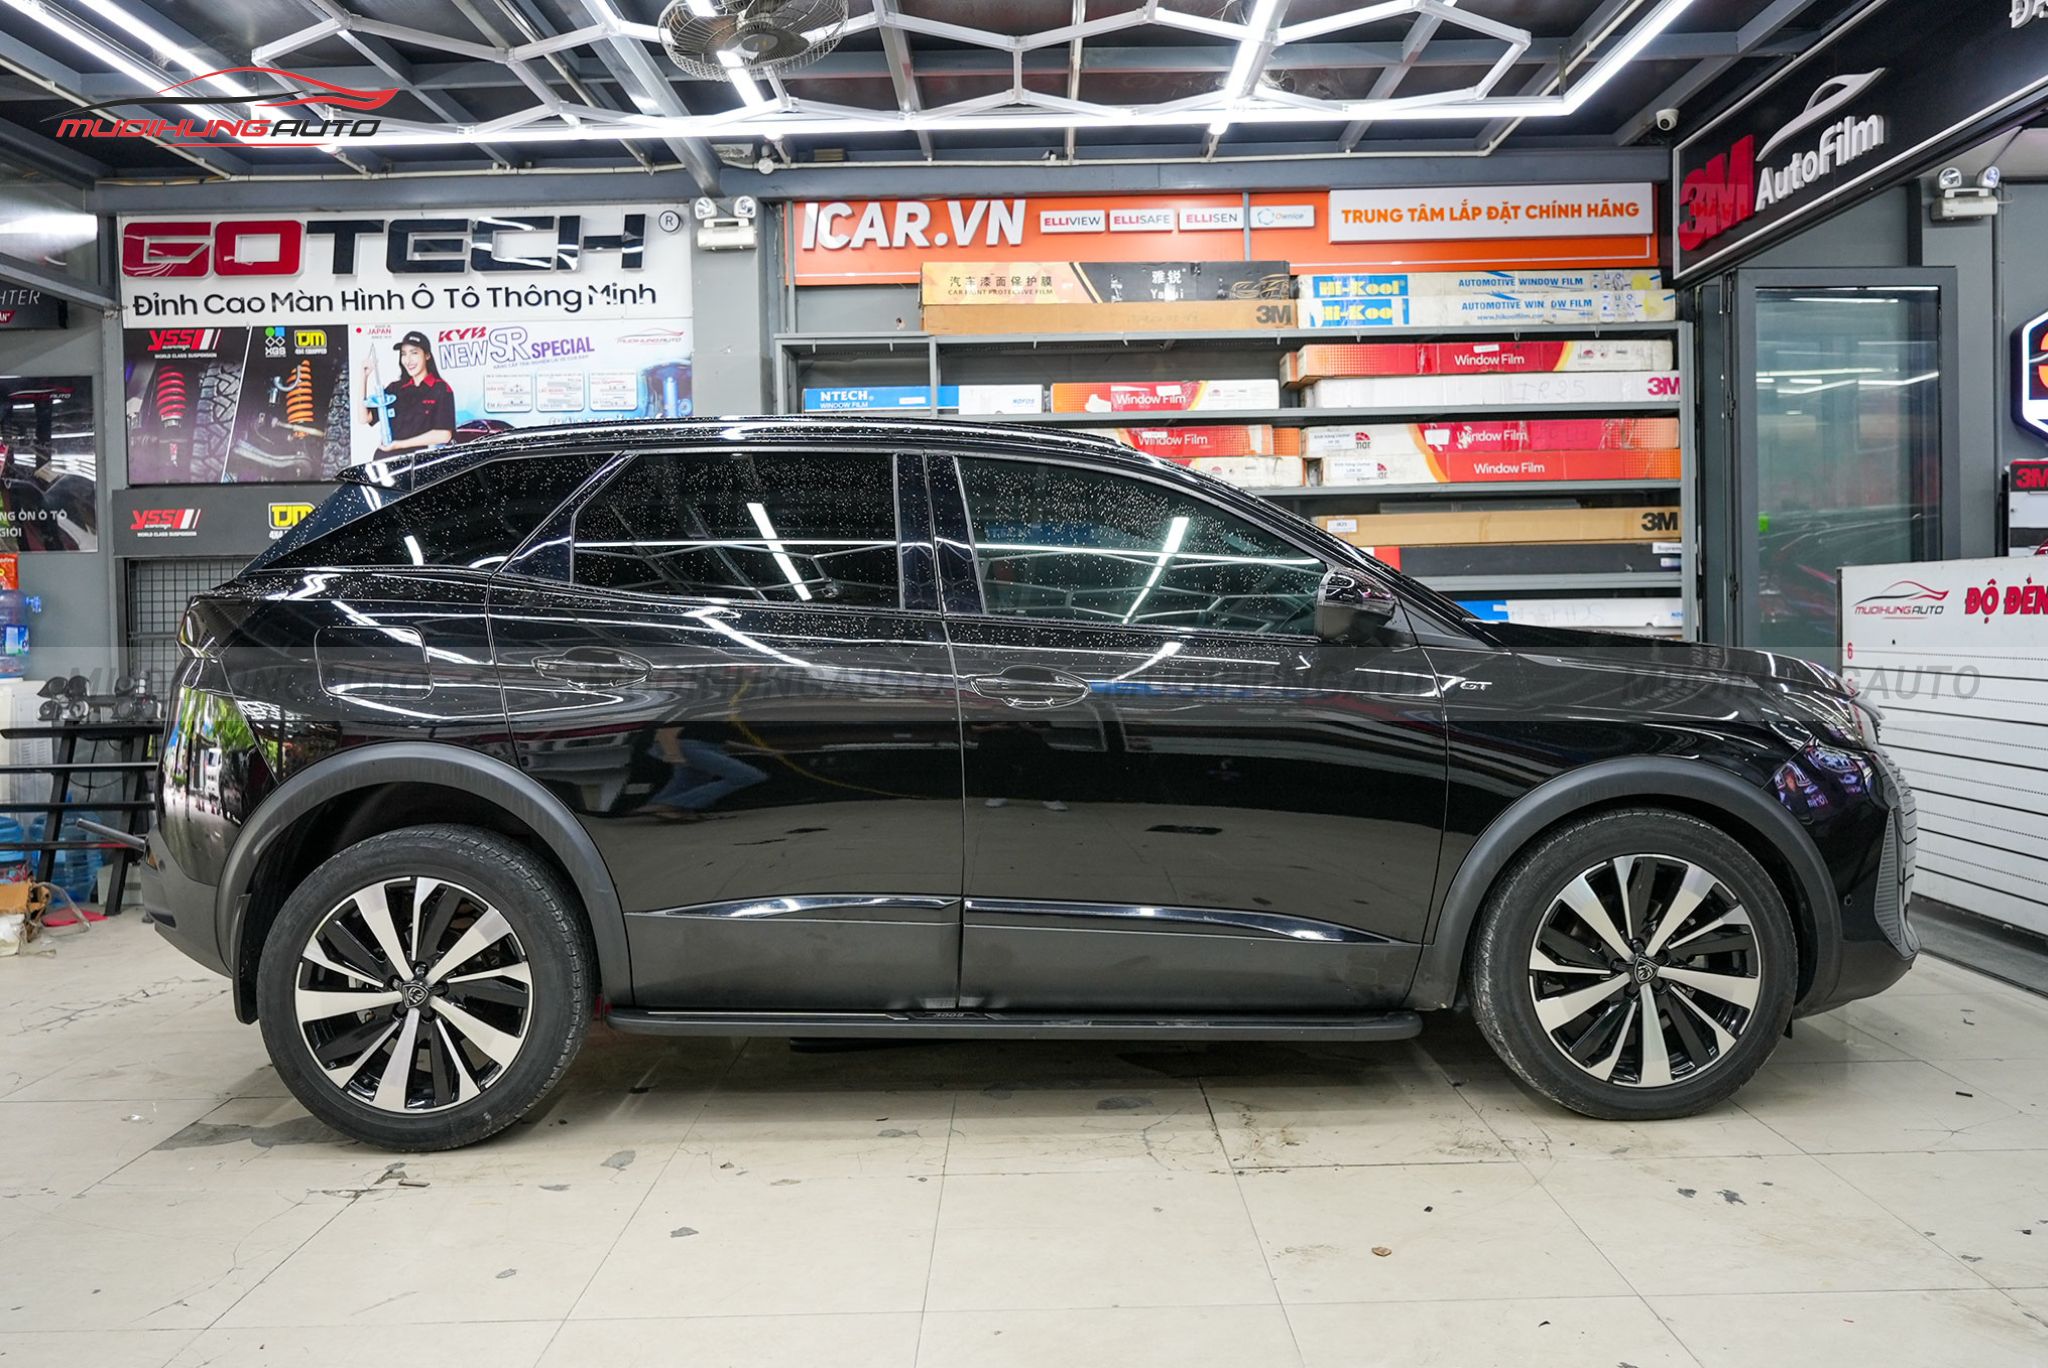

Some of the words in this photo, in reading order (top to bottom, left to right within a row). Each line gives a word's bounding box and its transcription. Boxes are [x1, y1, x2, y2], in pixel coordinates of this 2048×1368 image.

[1679, 134, 1755, 250] 3M
[1755, 115, 1885, 212] AutoFilm
[1186, 213, 1239, 223] ELLISEN
[1341, 207, 1404, 223] TRUNG
[1407, 203, 1445, 222] TÂM
[1449, 198, 1482, 221] LẮP
[1487, 201, 1521, 224] ĐẶT
[1525, 200, 1583, 219] CHÍNH
[1587, 198, 1639, 218] HÃNG
[803, 199, 1026, 249] ICAR.VN
[1044, 217, 1101, 227] ELLIVIEW
[1113, 215, 1171, 225] ELLISAFE
[122, 213, 647, 277] GOTECH
[1458, 278, 1516, 287] AUTOMOTIVE
[1519, 278, 1559, 286] WINDOW
[1561, 277, 1584, 286] FILM
[133, 292, 199, 316] Đỉnh
[204, 293, 266, 313] Cao
[271, 289, 333, 312] Màn
[341, 288, 405, 312] Hình
[412, 282, 435, 309] Ô
[443, 285, 480, 308] Tô
[487, 284, 582, 313] Thông
[588, 282, 656, 304] Minh
[1462, 301, 1521, 310] AUTOMOTIVE
[1570, 299, 1592, 308] FILM
[1256, 305, 1292, 324] 3M
[1323, 304, 1394, 320] Hi-Koo
[367, 327, 392, 335] JAPAN
[438, 326, 487, 342] KYB
[438, 340, 488, 370] NEW
[489, 326, 531, 364] SR
[531, 337, 595, 360] SPECIAL
[1454, 355, 1499, 366] Window
[1501, 354, 1525, 365] Film
[1647, 377, 1680, 395] 3M
[820, 391, 868, 401] NTECH
[1117, 393, 1161, 404] Window
[1162, 394, 1186, 404] Film
[1138, 434, 1182, 445] Window
[1184, 434, 1208, 445] Film
[1503, 430, 1528, 441] Film
[1474, 463, 1519, 475] Window
[1521, 462, 1546, 473] Film
[2015, 467, 2048, 489] 3M
[1641, 511, 1679, 531] 3M
[1965, 578, 1999, 624] ĐỘ
[1846, 642, 1854, 660] 6
[1460, 681, 1493, 691] GT
